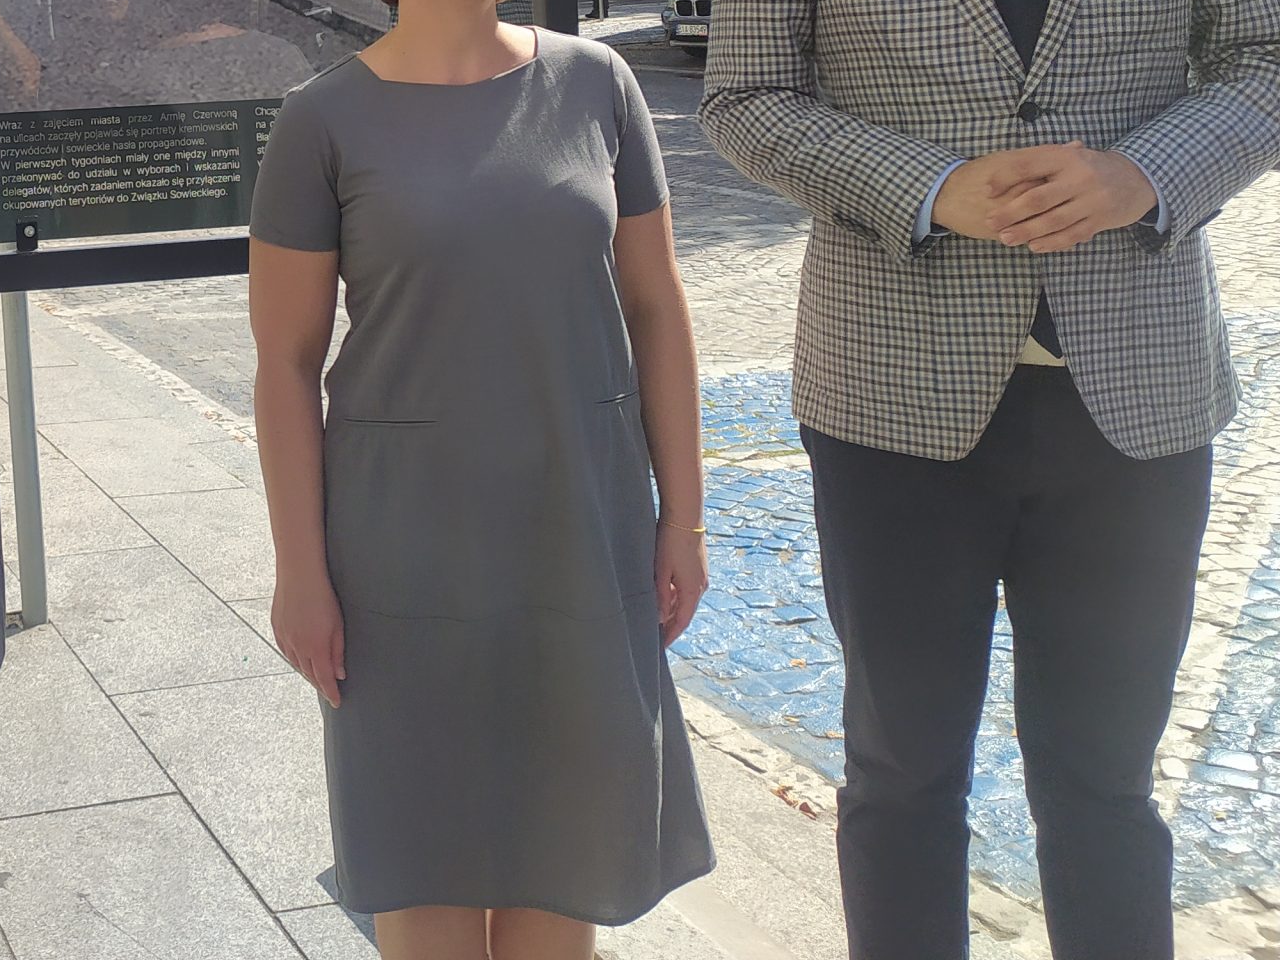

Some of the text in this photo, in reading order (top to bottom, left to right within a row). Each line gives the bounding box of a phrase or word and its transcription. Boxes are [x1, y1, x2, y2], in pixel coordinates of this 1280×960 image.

[0, 120, 22, 130] Wraz
[43, 117, 84, 130] zajęciem
[90, 115, 121, 126] miasta
[128, 113, 153, 124] przez
[160, 111, 186, 123] Armię
[193, 109, 238, 120] Czerwoną
[255, 120, 267, 129] na
[0, 121, 239, 144] na ulicach zaczęły pojawiać się portrety kremlowskich
[0, 145, 59, 159] przywódców
[66, 142, 111, 154] sowieckie
[113, 140, 137, 150] hasła
[138, 137, 208, 149] propagandowe.
[1, 146, 240, 171] W pierwszych tygodniach miały one między innymi
[2, 171, 63, 185] przekonywać
[67, 170, 80, 179] do
[122, 167, 131, 176] w
[137, 163, 181, 177] wyborach
[194, 160, 240, 172] wskazaniu
[2, 172, 241, 198] delegatów, których zadaniem okazało się przyłączenie
[3, 187, 229, 211] okupowanych terytoriów do Związku Sowieckiego.
